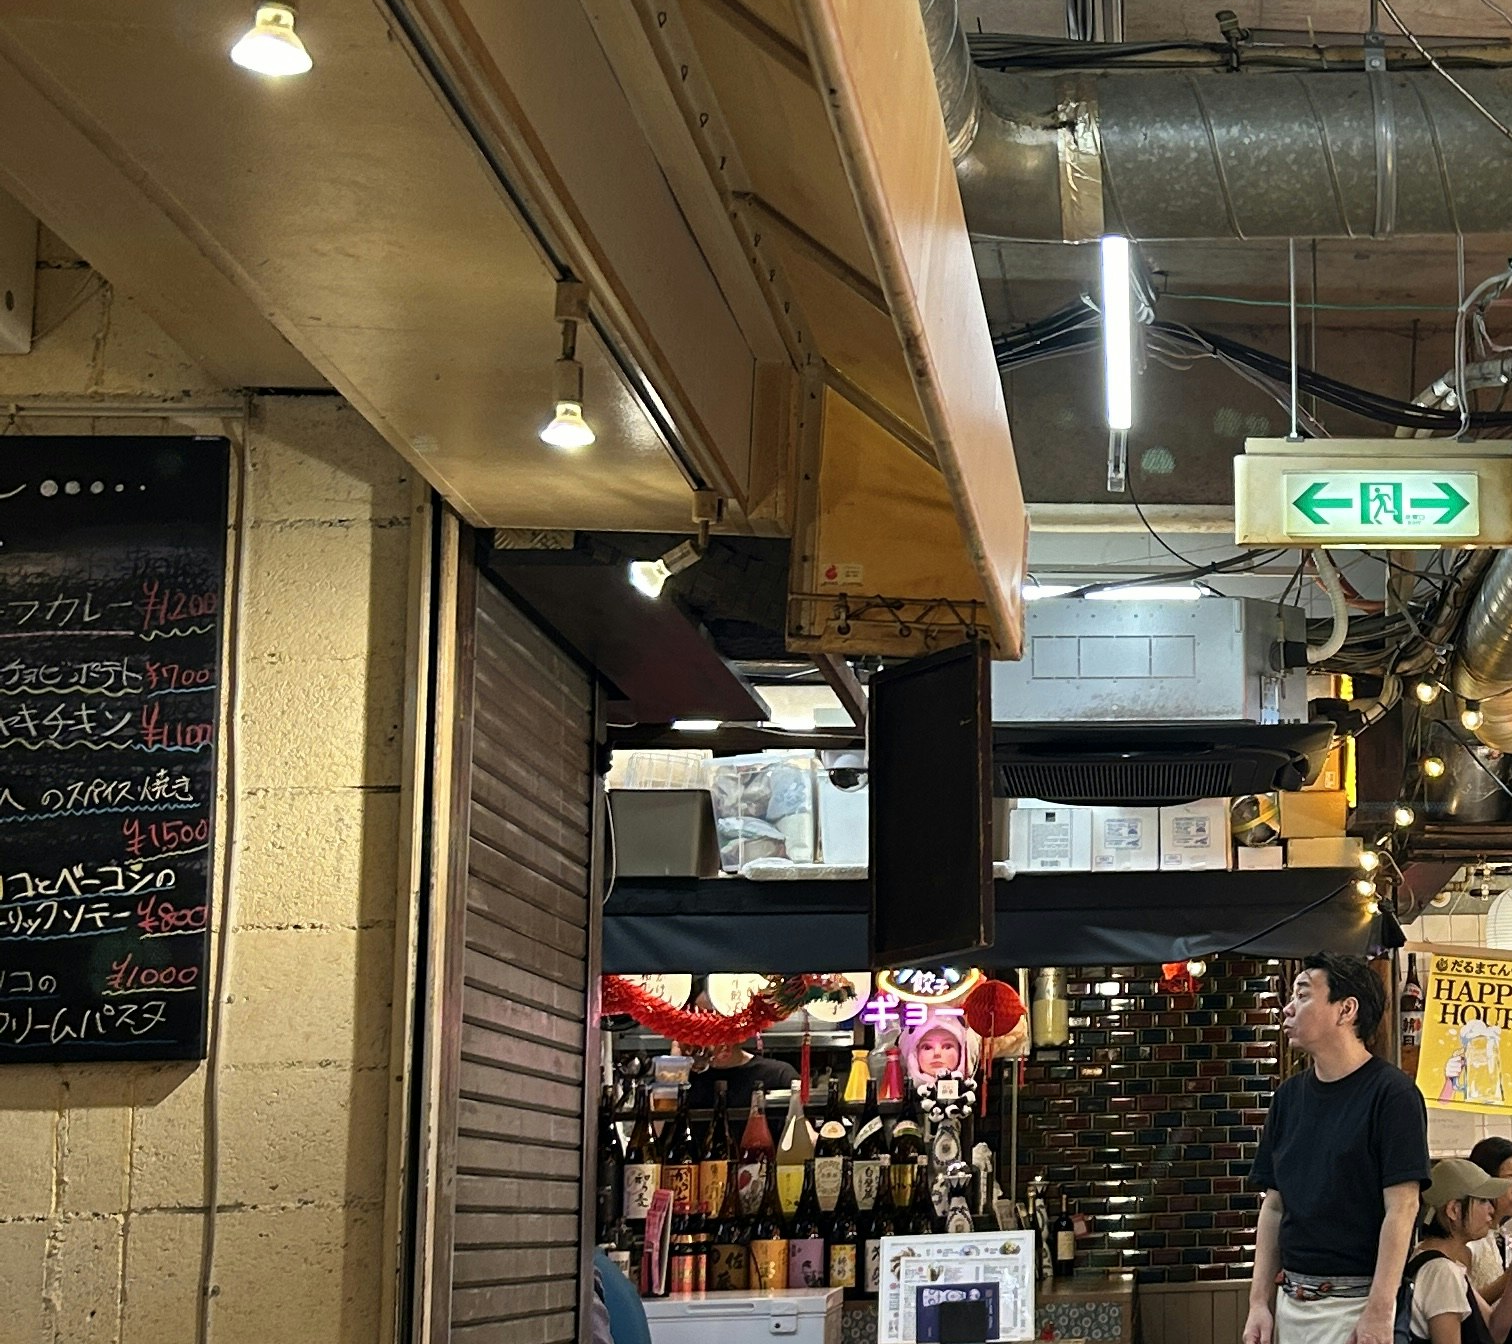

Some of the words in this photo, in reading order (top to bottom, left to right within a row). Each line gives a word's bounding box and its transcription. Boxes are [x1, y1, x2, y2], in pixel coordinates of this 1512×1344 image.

[146, 661, 211, 689] ¥700
[910, 969, 951, 995] 餃子
[865, 995, 966, 1029] ギョー
